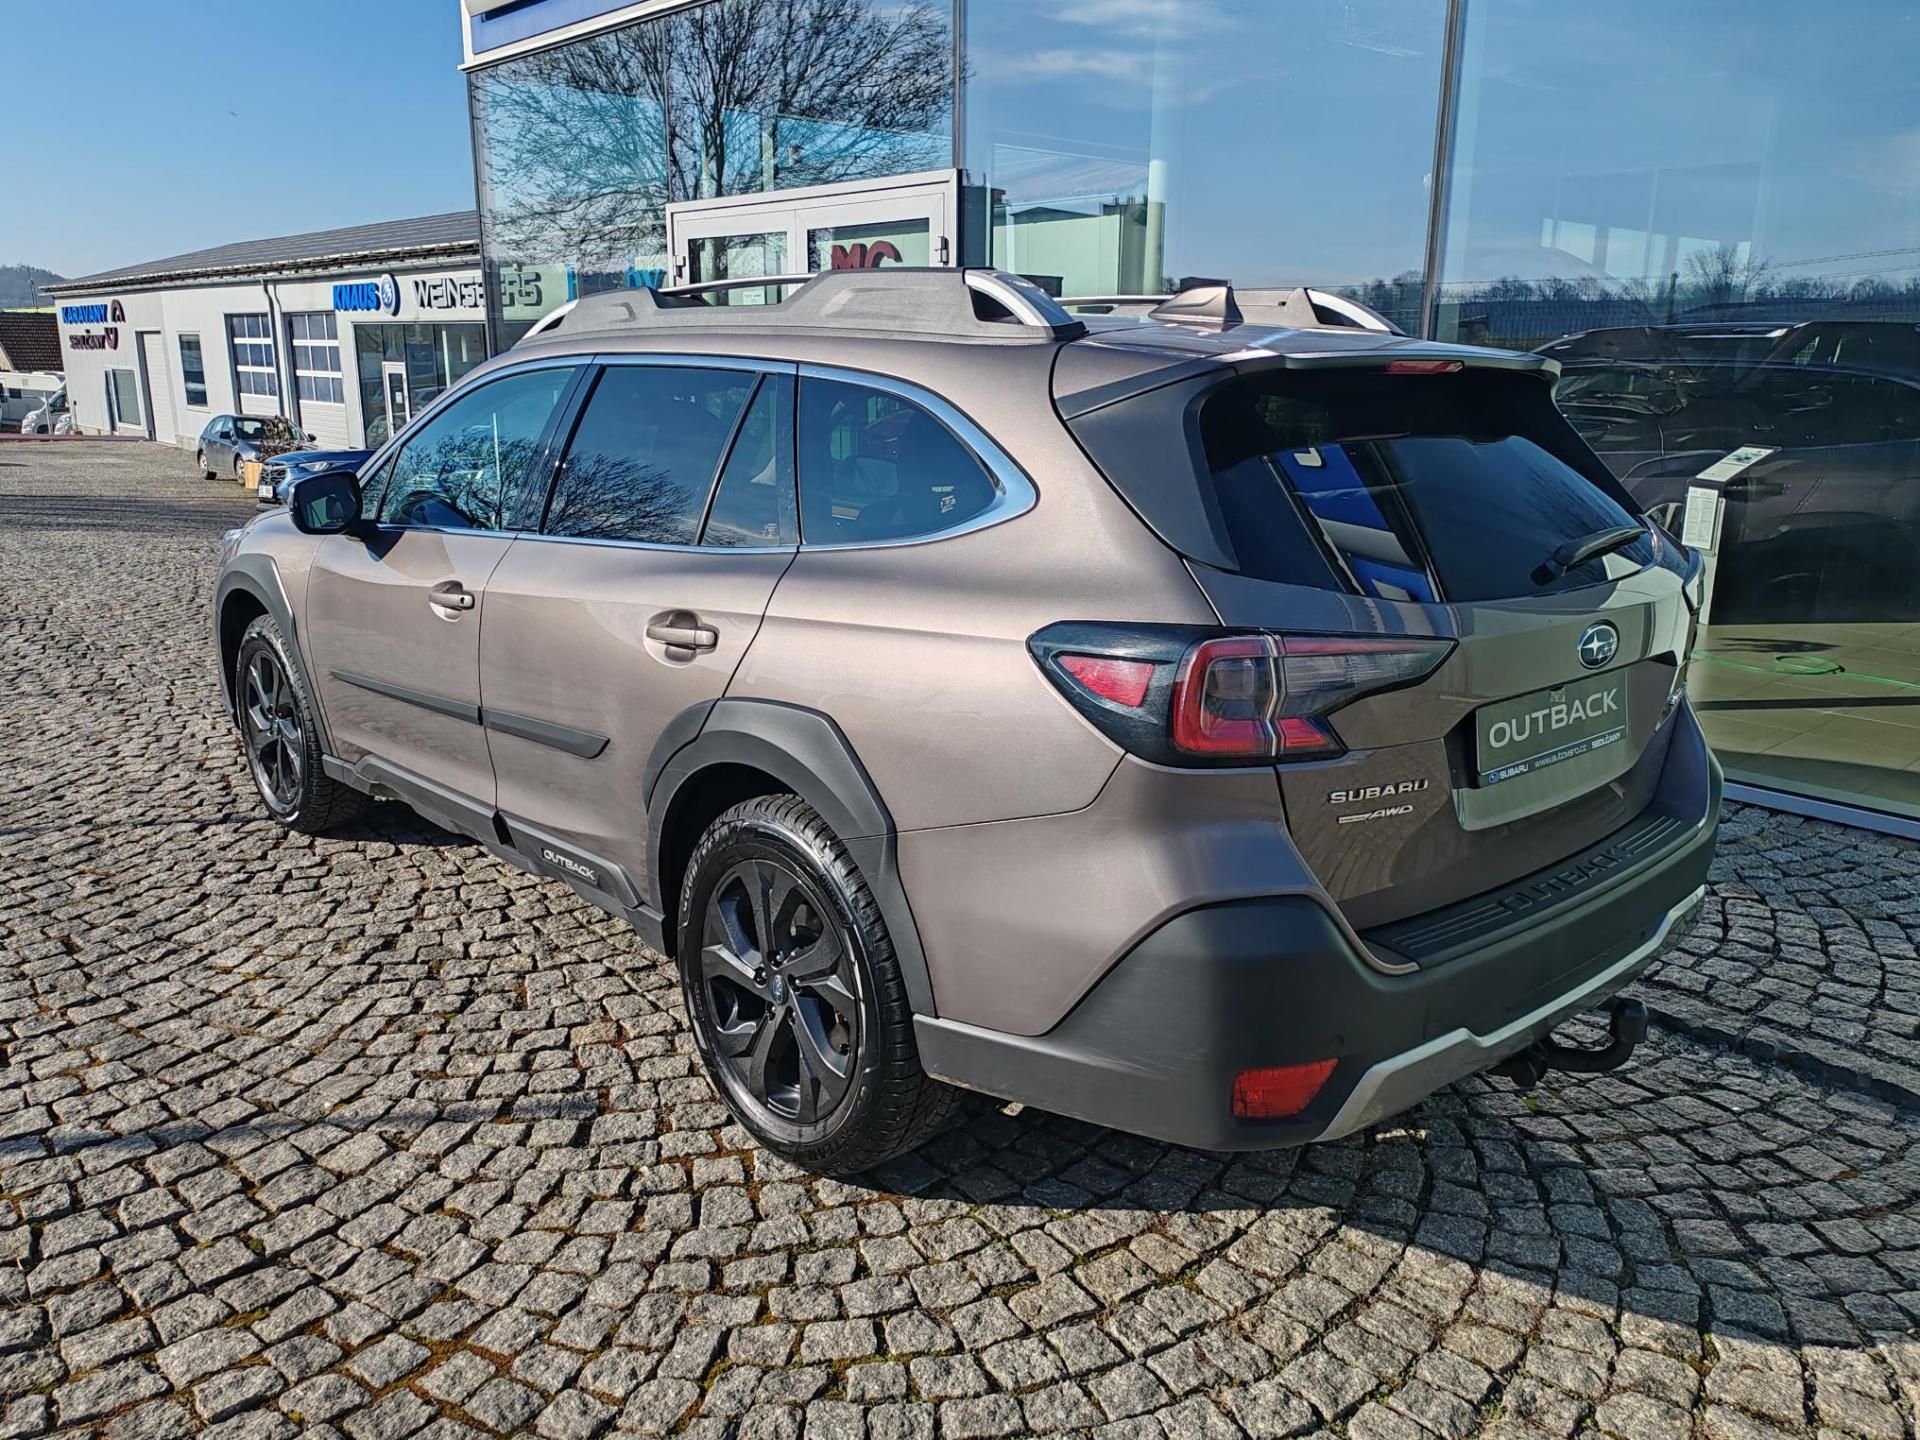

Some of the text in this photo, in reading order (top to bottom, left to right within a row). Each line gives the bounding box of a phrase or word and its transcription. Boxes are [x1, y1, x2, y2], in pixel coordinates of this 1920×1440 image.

[333, 282, 381, 312] KNAUS
[413, 271, 543, 311] WEINSBRG
[61, 304, 108, 324] KARAVANY
[1488, 687, 1619, 749] OUTBACK
[1499, 763, 1529, 780] SUBARU
[1328, 779, 1429, 804] SUBARU
[1368, 804, 1414, 820] AWD
[543, 849, 596, 881] OUTBACK
[1498, 846, 1633, 911] OUTBACK
